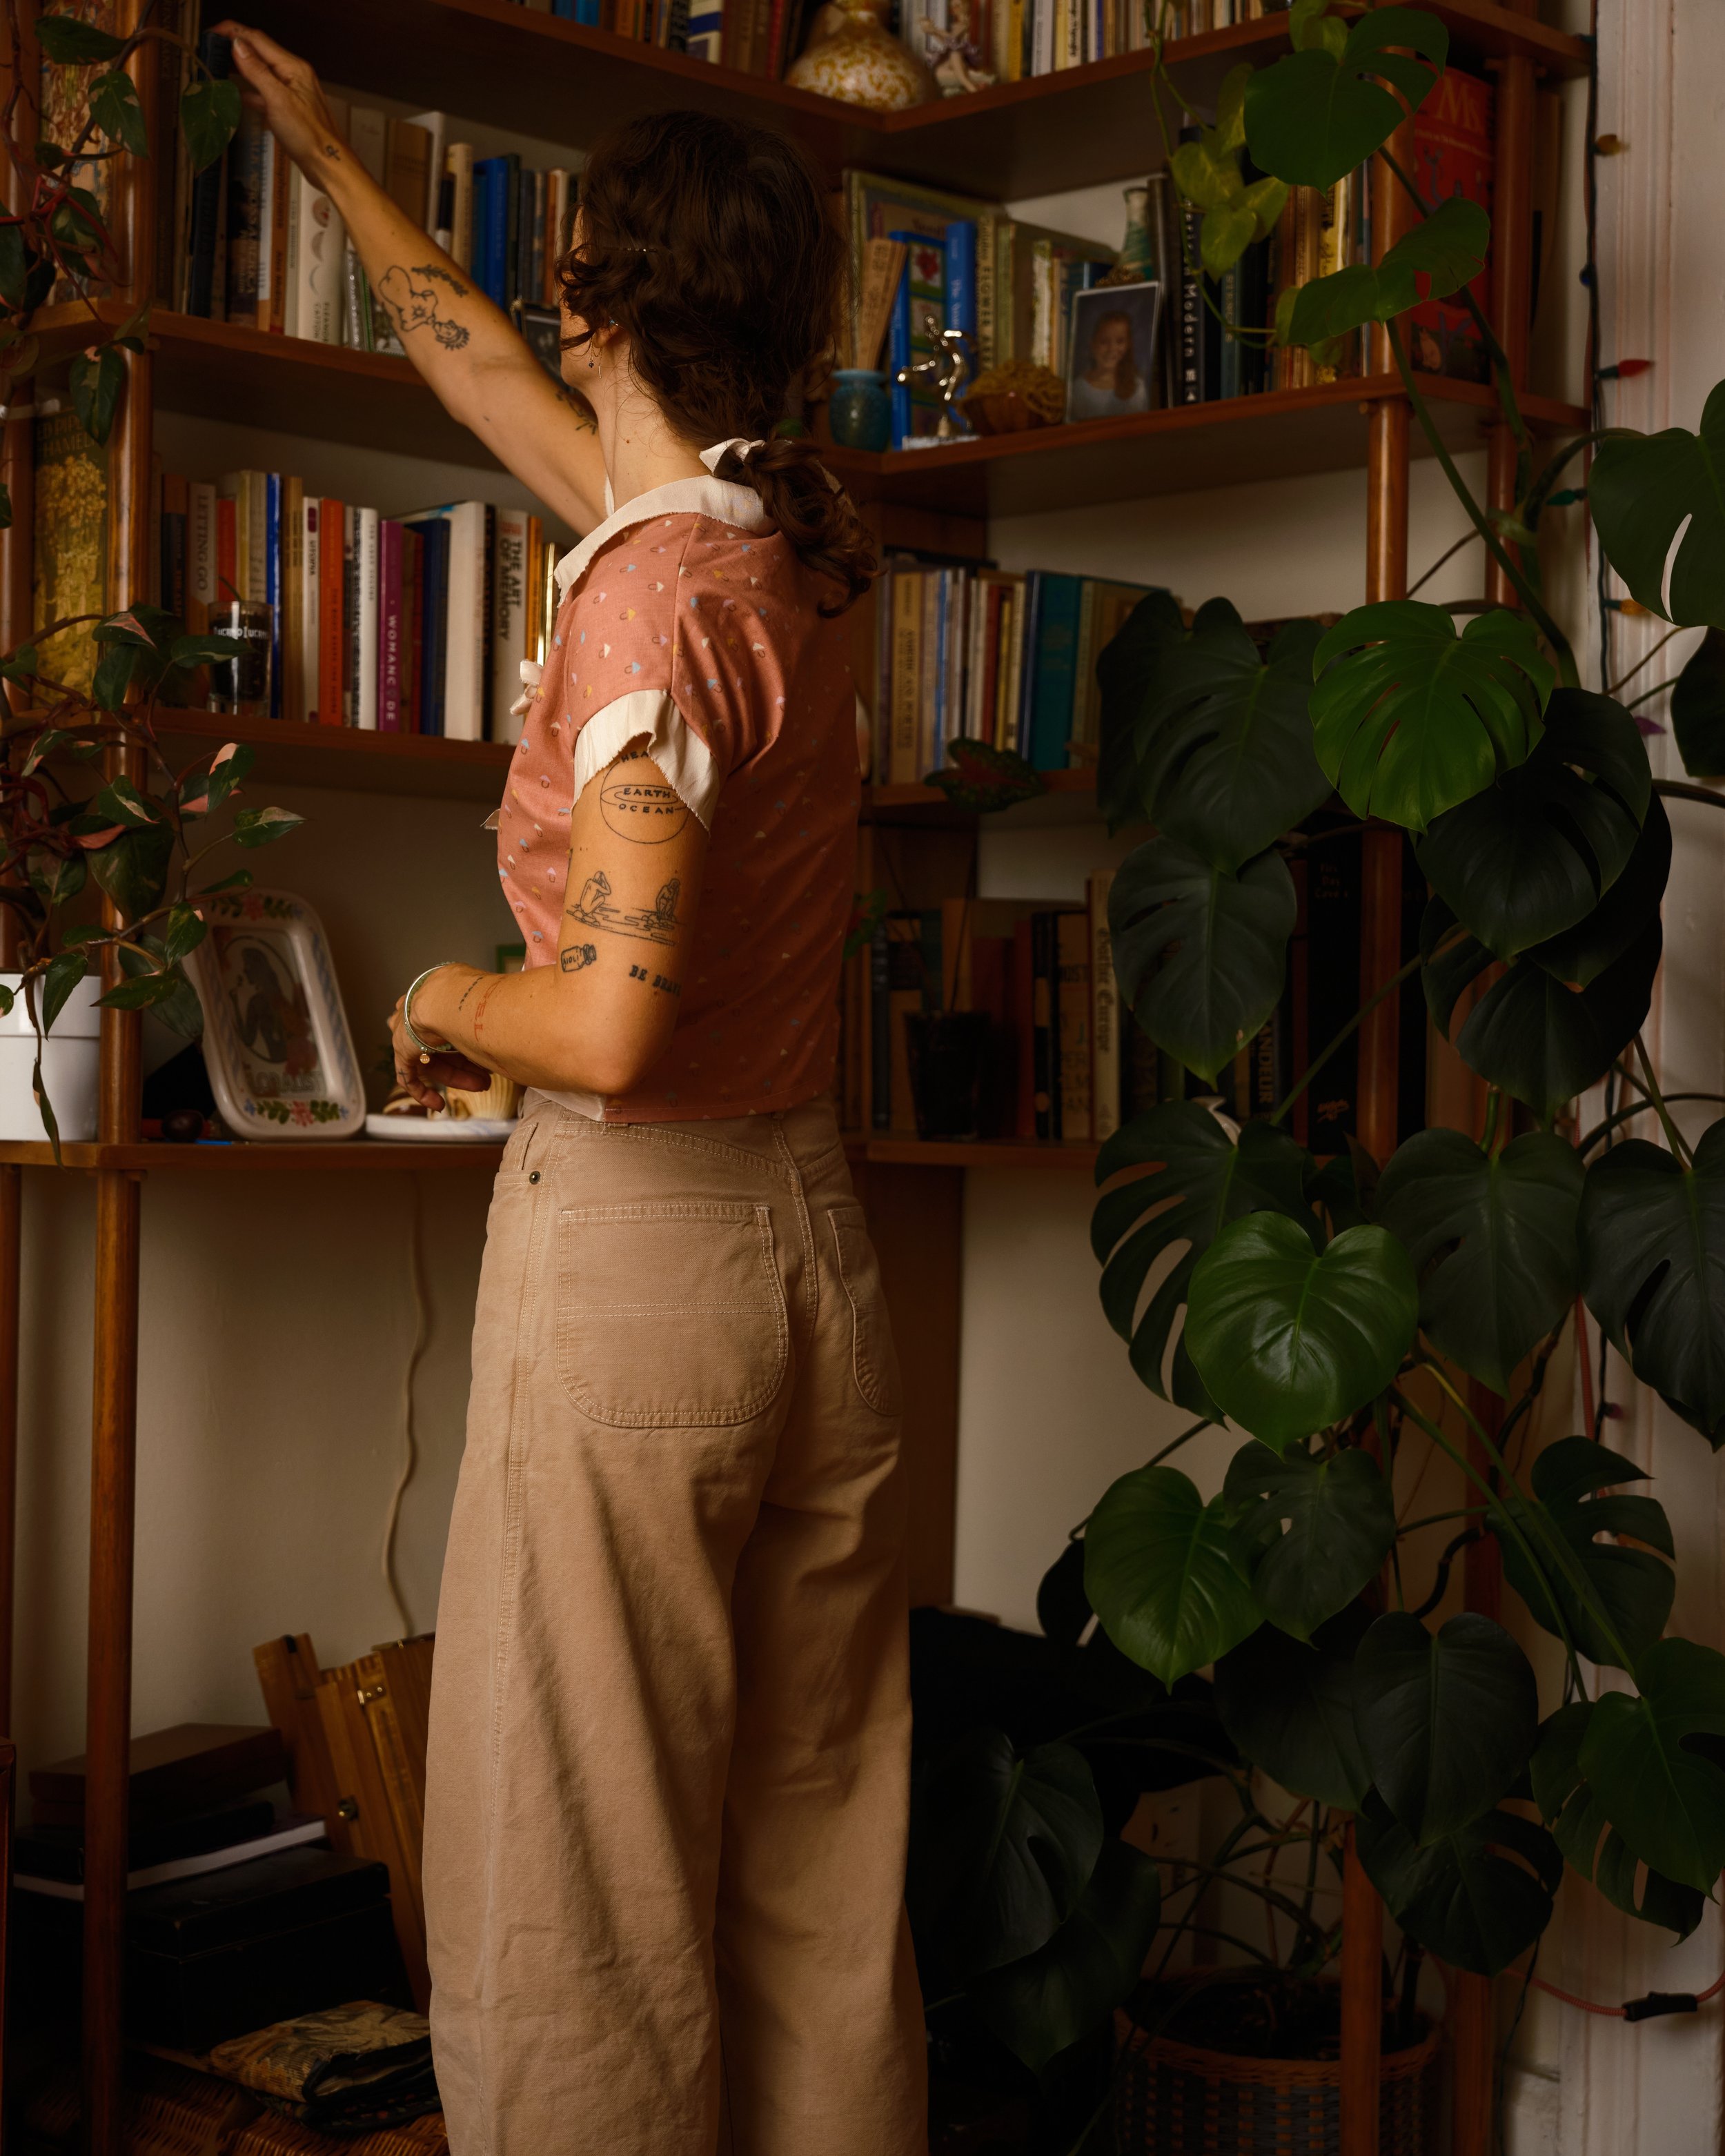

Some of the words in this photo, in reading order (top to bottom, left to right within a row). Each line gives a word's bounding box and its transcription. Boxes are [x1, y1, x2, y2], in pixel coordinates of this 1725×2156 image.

[1183, 282, 1199, 357] Modern
[197, 494, 209, 563] LETTING
[499, 538, 511, 560] OF
[511, 540, 522, 570] THE
[197, 566, 208, 591] GO
[510, 575, 522, 609] ART
[497, 565, 511, 641] MEMORY
[620, 750, 649, 763] HEA
[622, 787, 671, 799] EARTH
[618, 803, 674, 815] OCEAN
[629, 964, 648, 981] BE
[1096, 989, 1114, 1054] Europe
[1258, 1025, 1274, 1103] ANDEUR
